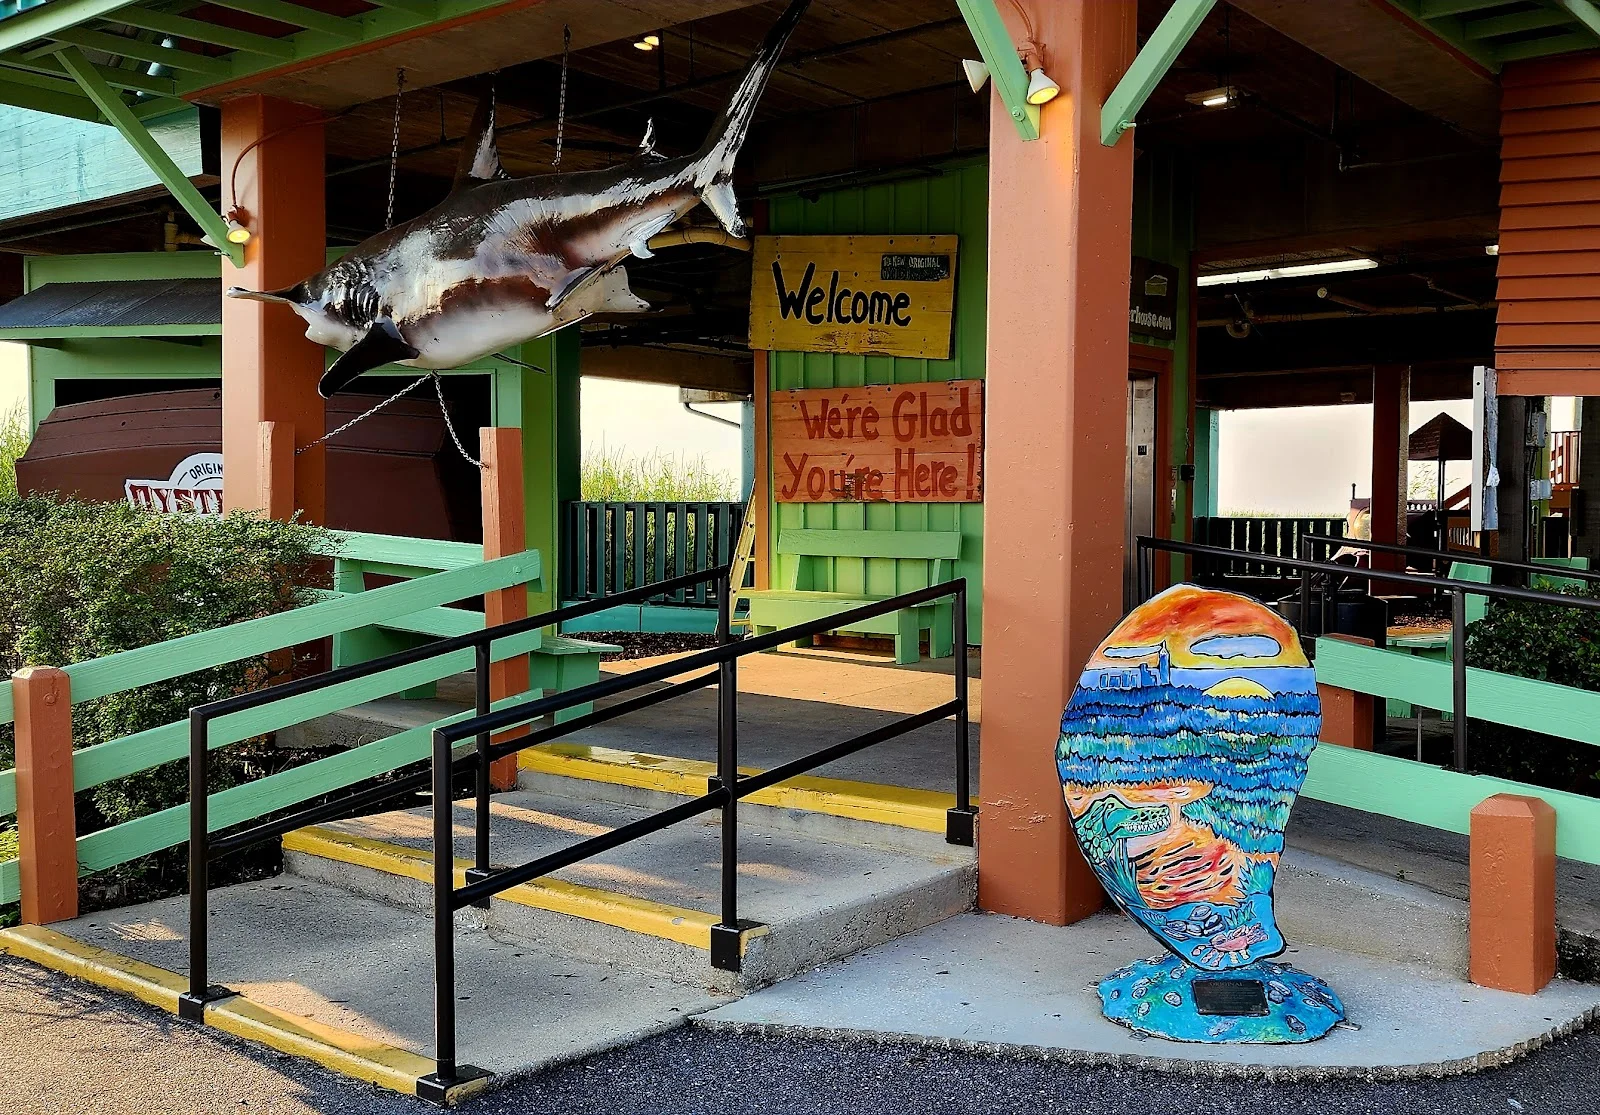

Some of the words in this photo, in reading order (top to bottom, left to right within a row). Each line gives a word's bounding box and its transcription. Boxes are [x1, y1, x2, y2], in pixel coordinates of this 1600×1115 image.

[908, 256, 940, 268] ORIGINAL
[771, 260, 912, 327] Welcome
[1129, 305, 1172, 331] rhouse.com
[799, 393, 880, 440] We're
[892, 387, 973, 443] Glad
[189, 462, 223, 480] ORIGIN
[781, 451, 884, 500] You're
